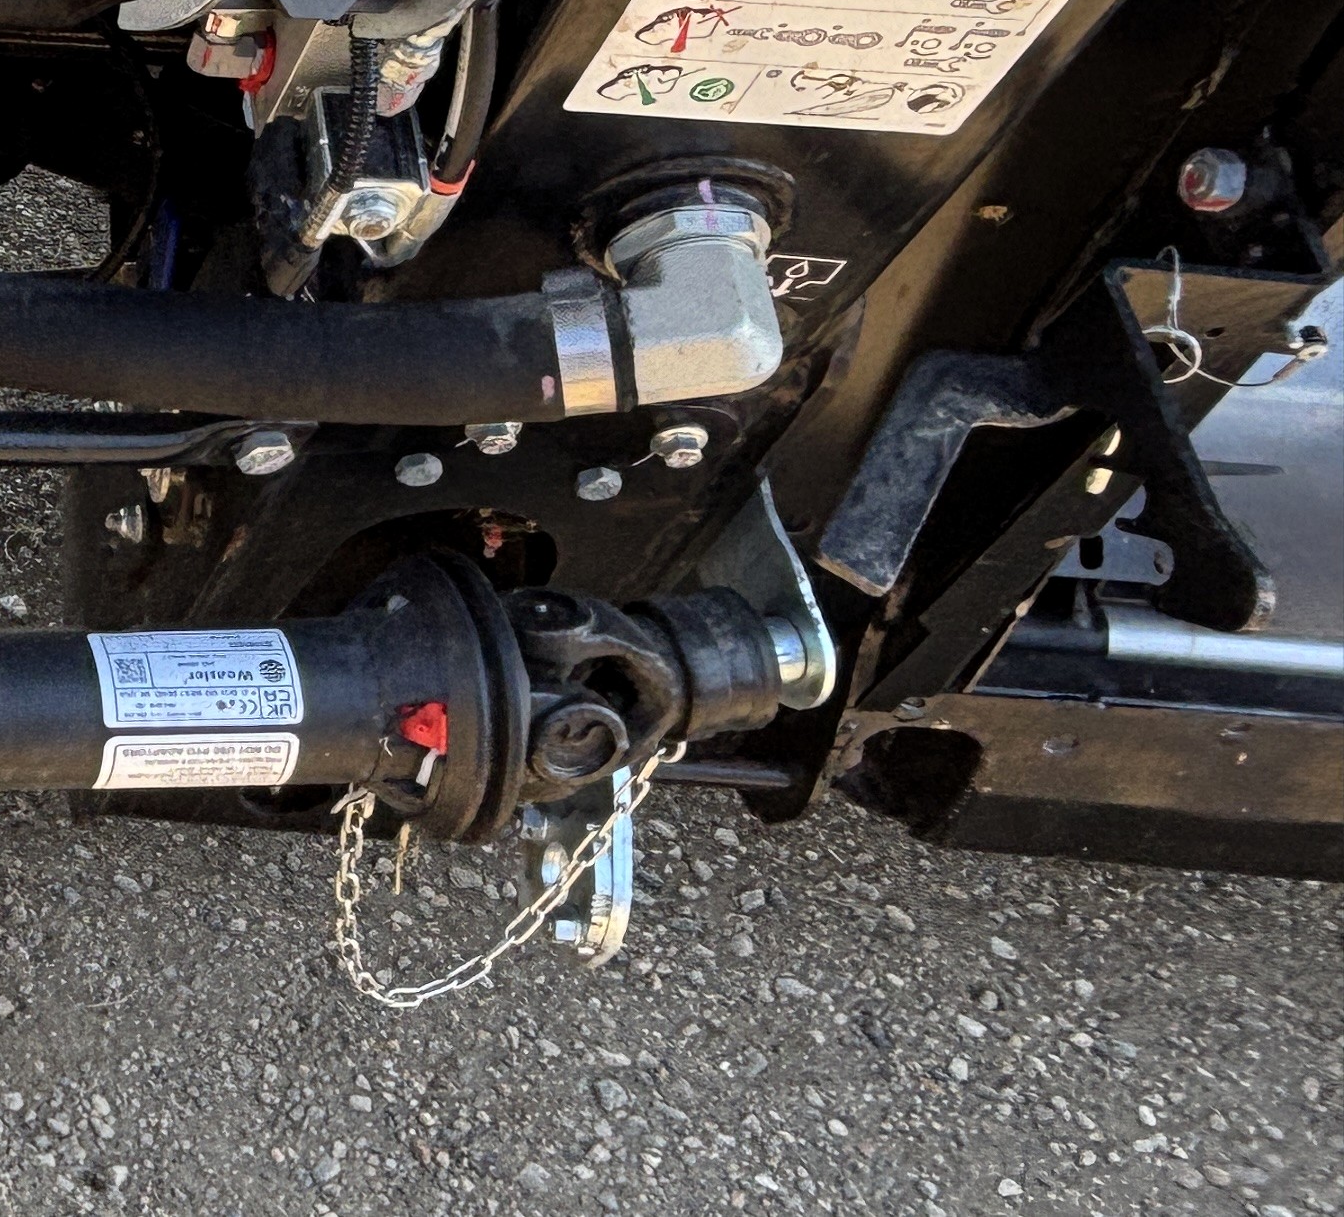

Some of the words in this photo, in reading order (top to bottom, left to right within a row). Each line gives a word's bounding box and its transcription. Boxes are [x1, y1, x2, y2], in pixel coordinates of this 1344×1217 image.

[263, 689, 291, 702] CA
[238, 699, 259, 715] CE
[266, 703, 292, 718] UK
